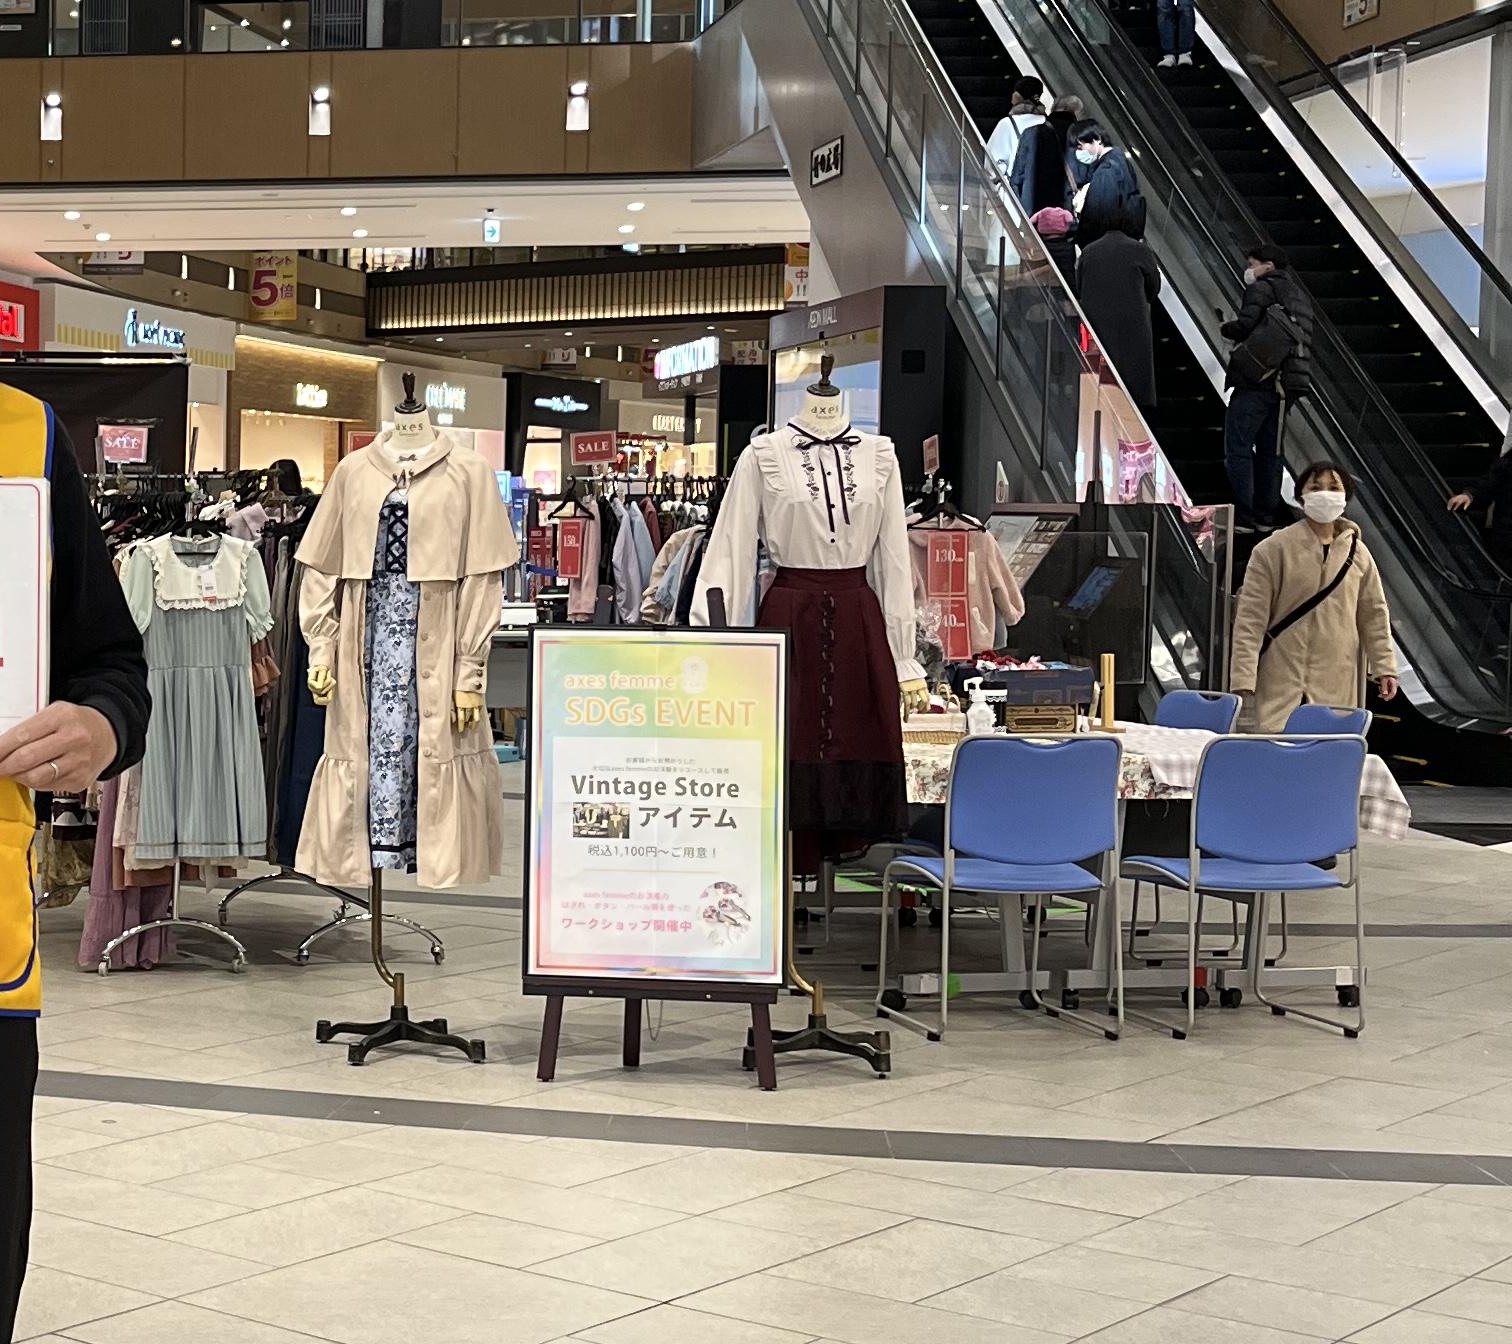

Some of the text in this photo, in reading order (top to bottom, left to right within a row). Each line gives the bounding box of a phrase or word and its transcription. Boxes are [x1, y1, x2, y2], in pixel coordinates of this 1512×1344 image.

[254, 256, 292, 266] ポイント
[104, 436, 141, 450] SALE
[577, 440, 610, 454] SALE
[565, 671, 675, 689] axes femme
[566, 697, 756, 727] SDGs EVENT
[571, 774, 740, 801] Vintage Store
[638, 806, 738, 829] アイテム
[561, 917, 693, 933] ワークショップ開催中
